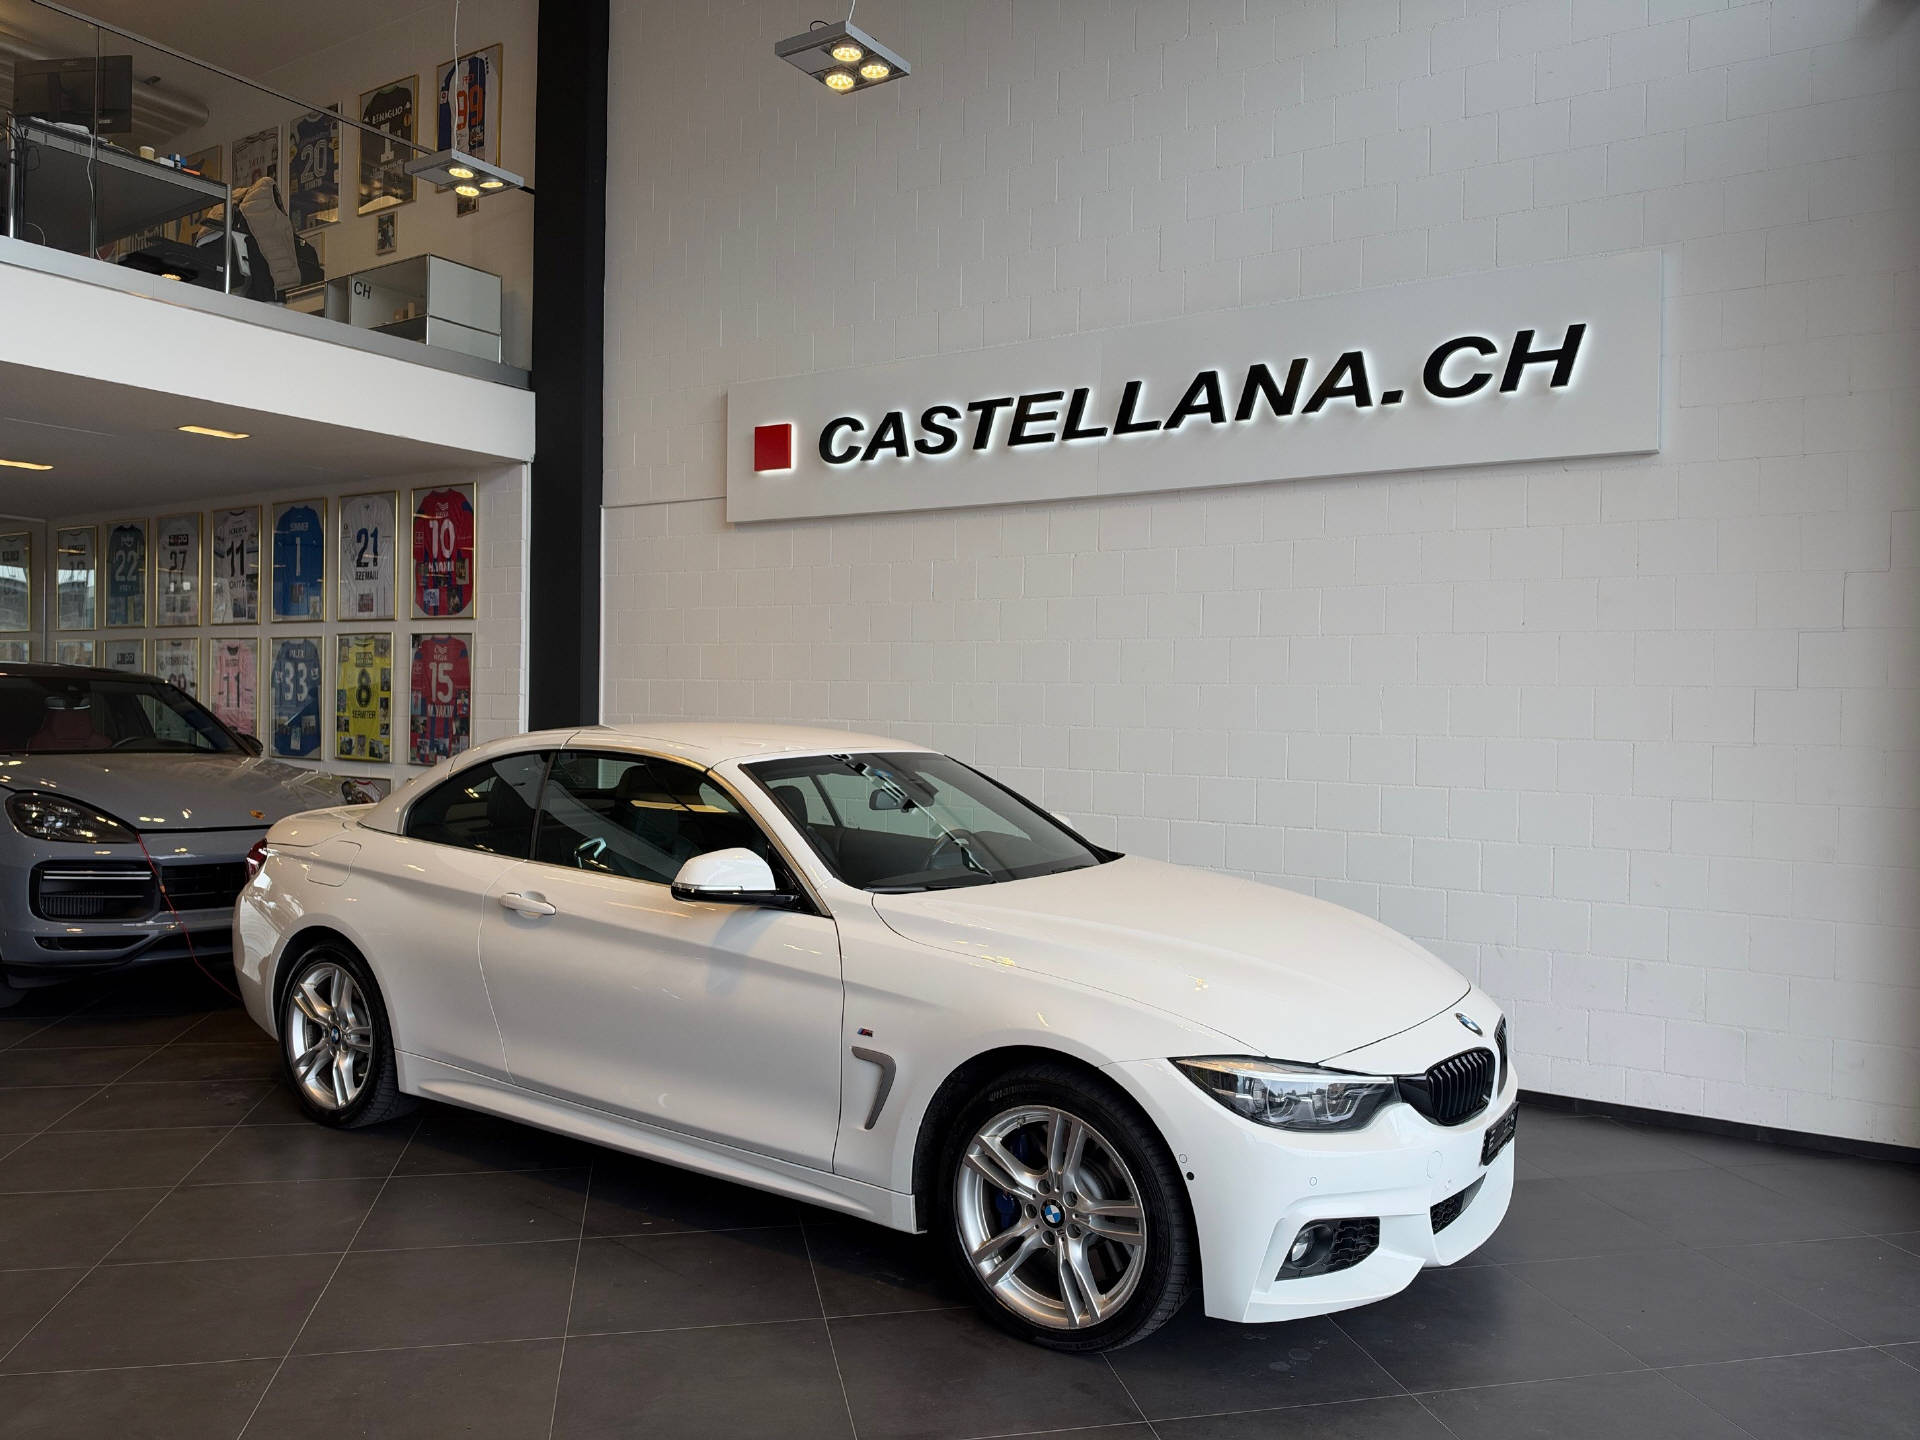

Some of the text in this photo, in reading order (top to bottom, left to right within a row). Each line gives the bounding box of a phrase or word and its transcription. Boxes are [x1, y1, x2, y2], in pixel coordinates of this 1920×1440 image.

[301, 139, 328, 183] 20
[353, 281, 372, 299] CH
[818, 323, 1587, 464] CASTELLANA.CH
[226, 539, 245, 577] 11
[356, 527, 379, 568] 21
[429, 519, 456, 559] 10
[115, 550, 138, 582] 22
[223, 672, 240, 708] 11
[284, 662, 308, 702] 33
[356, 668, 372, 708] 8
[429, 662, 454, 703] 15
